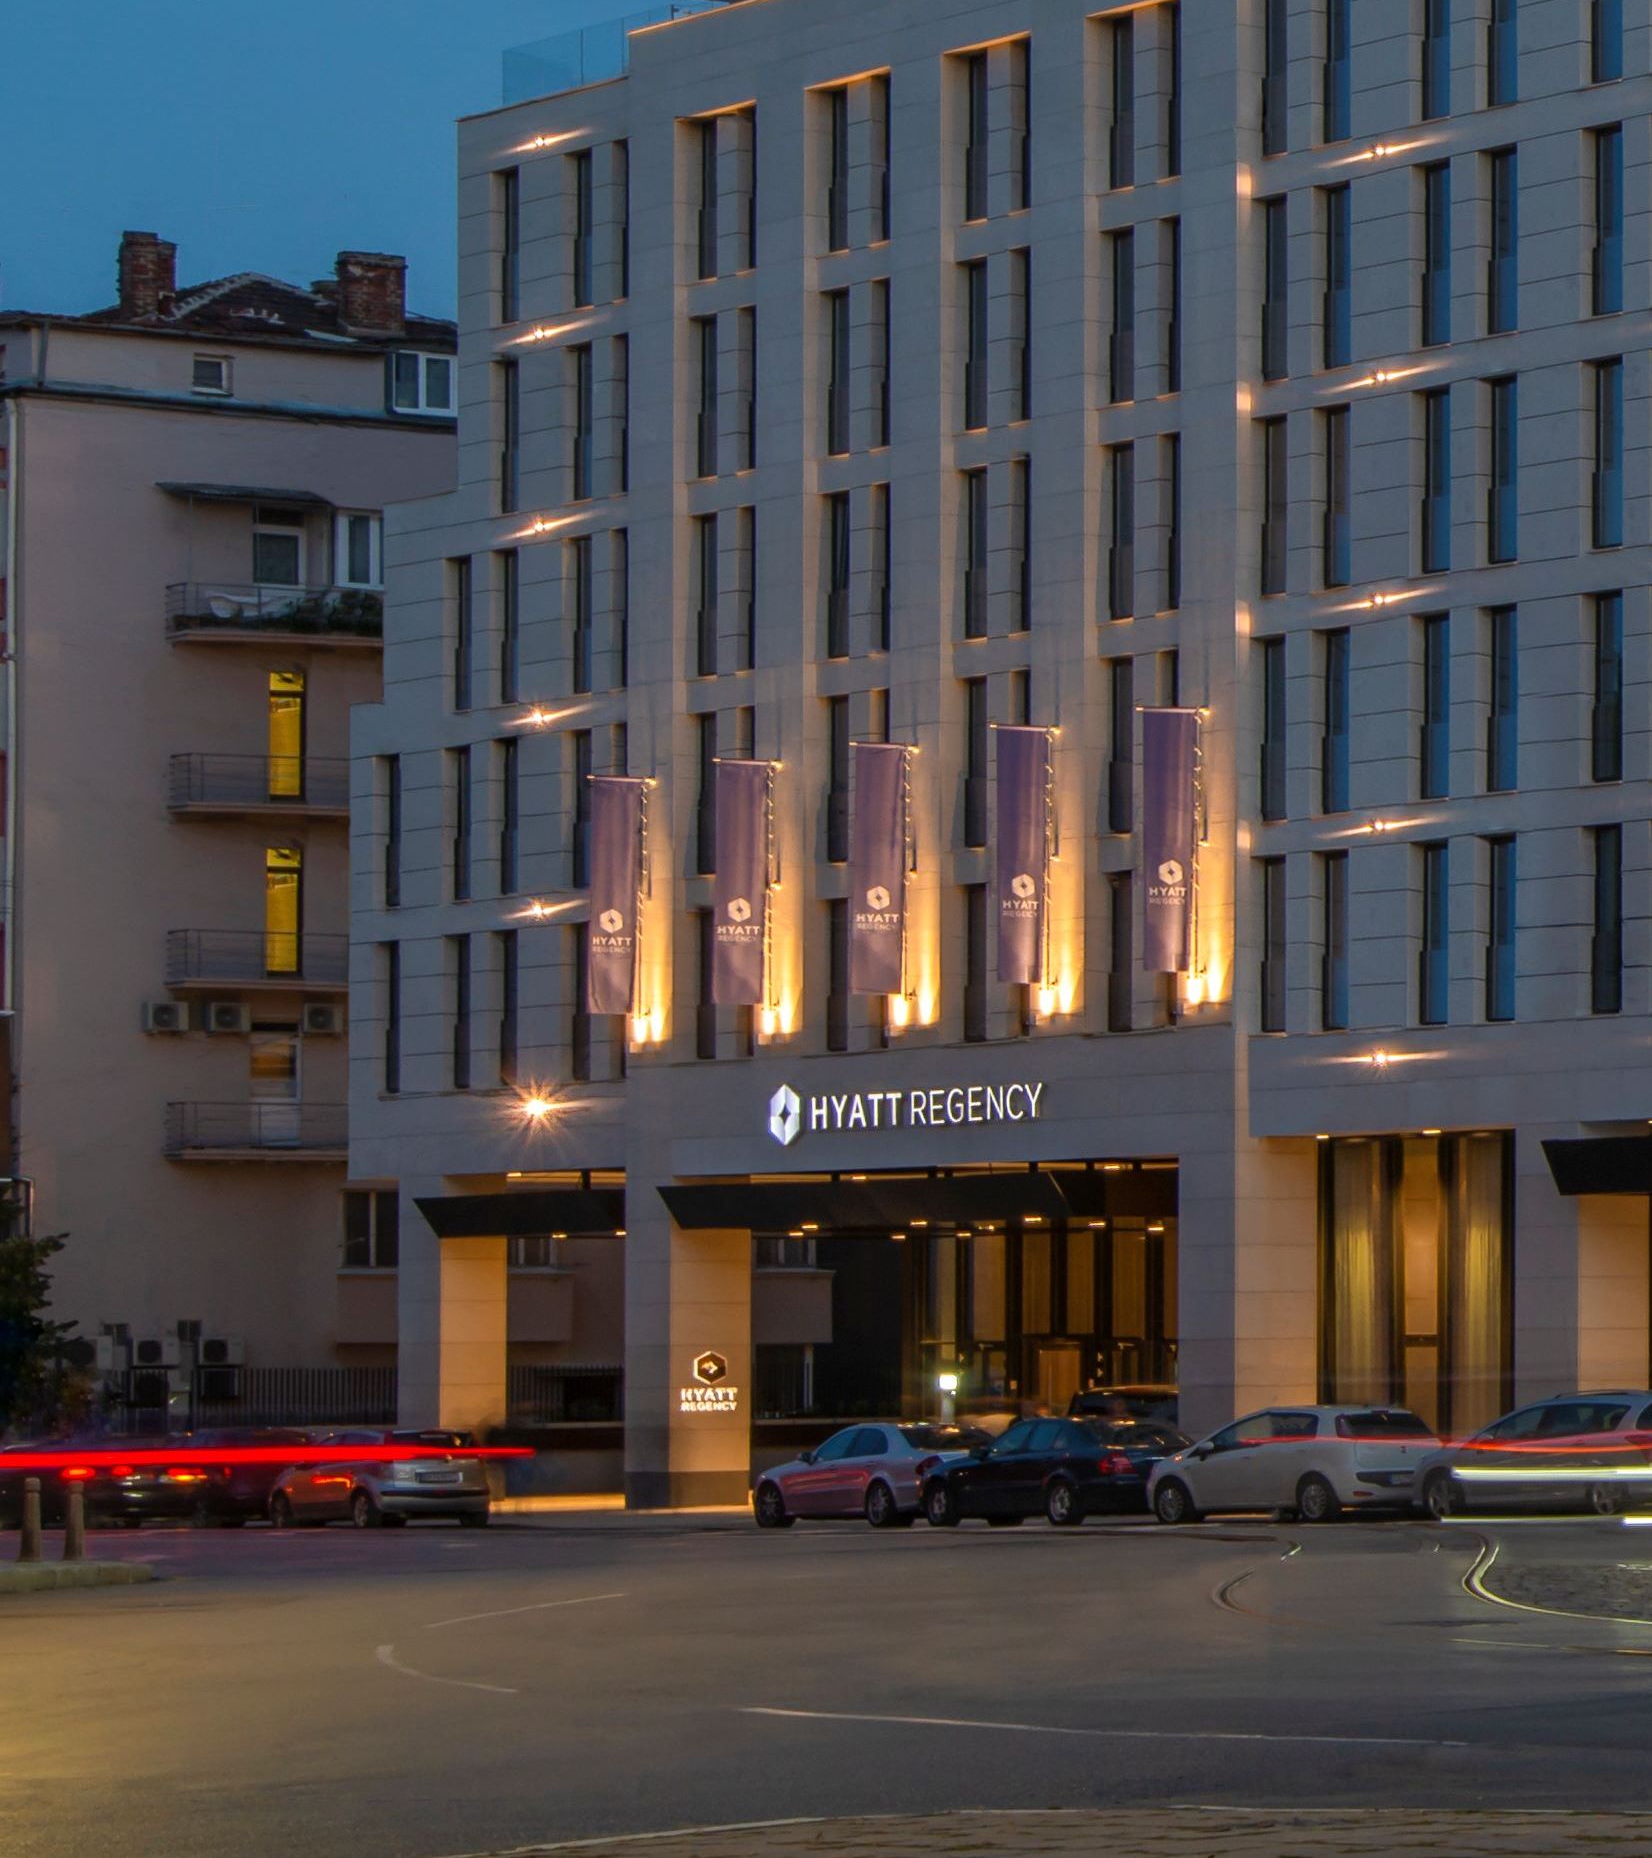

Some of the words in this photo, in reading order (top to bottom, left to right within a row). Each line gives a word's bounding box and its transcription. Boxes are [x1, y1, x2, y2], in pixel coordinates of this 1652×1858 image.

[1148, 886, 1187, 897] HYATT
[1002, 900, 1039, 910] HYATT
[856, 913, 899, 923] HYATT
[717, 925, 760, 935] HYATT
[592, 937, 632, 946] HYATT
[811, 1093, 902, 1130] HYATT
[910, 1082, 1043, 1126] REGENCY
[680, 1387, 738, 1401] HYATT
[680, 1401, 737, 1412] REGENCY
